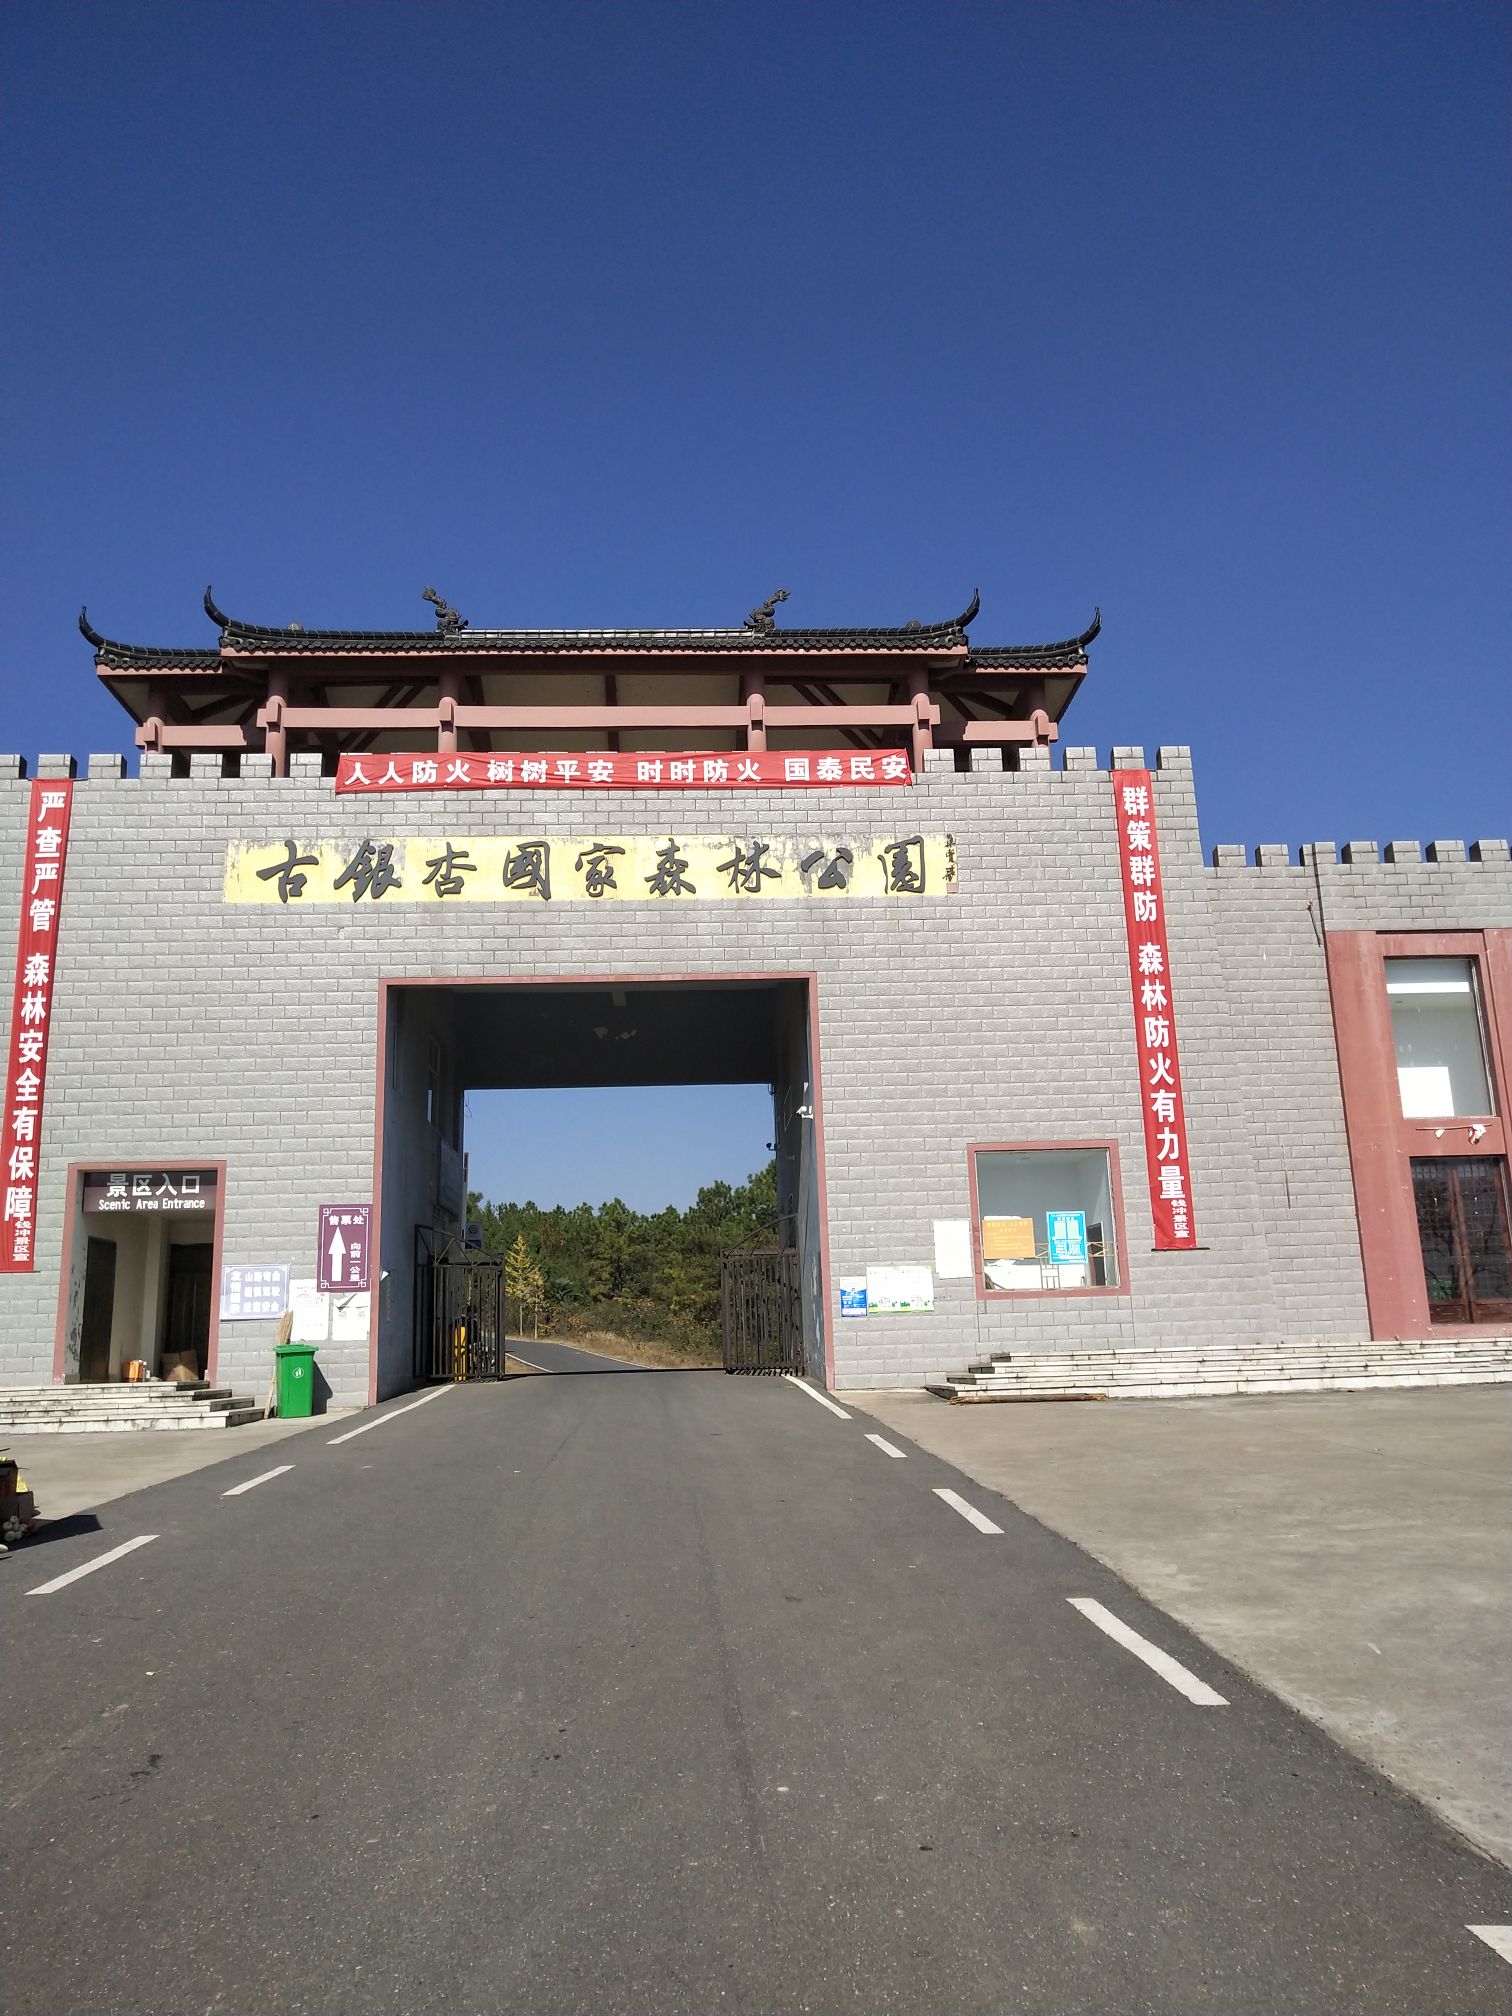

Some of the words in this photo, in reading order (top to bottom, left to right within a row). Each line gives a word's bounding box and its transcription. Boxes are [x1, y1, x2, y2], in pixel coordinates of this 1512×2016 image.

[344, 759, 471, 785] 人人防火
[487, 759, 614, 784] 树树平安
[637, 759, 761, 785] 时时防火
[784, 755, 908, 783] 国泰民安
[29, 791, 67, 931] 严查严管
[1121, 786, 1159, 923] 群策群防
[4, 952, 51, 1222] 森林安全有保障
[1138, 942, 1186, 1201] 森林防火有力量
[98, 1198, 131, 1210] Scenic
[136, 1198, 159, 1210] Area
[162, 1197, 206, 1210] Entrance
[107, 1174, 201, 1198] 景区入口
[329, 1215, 365, 1226] 售票处
[349, 1243, 362, 1282] 向前一公里
